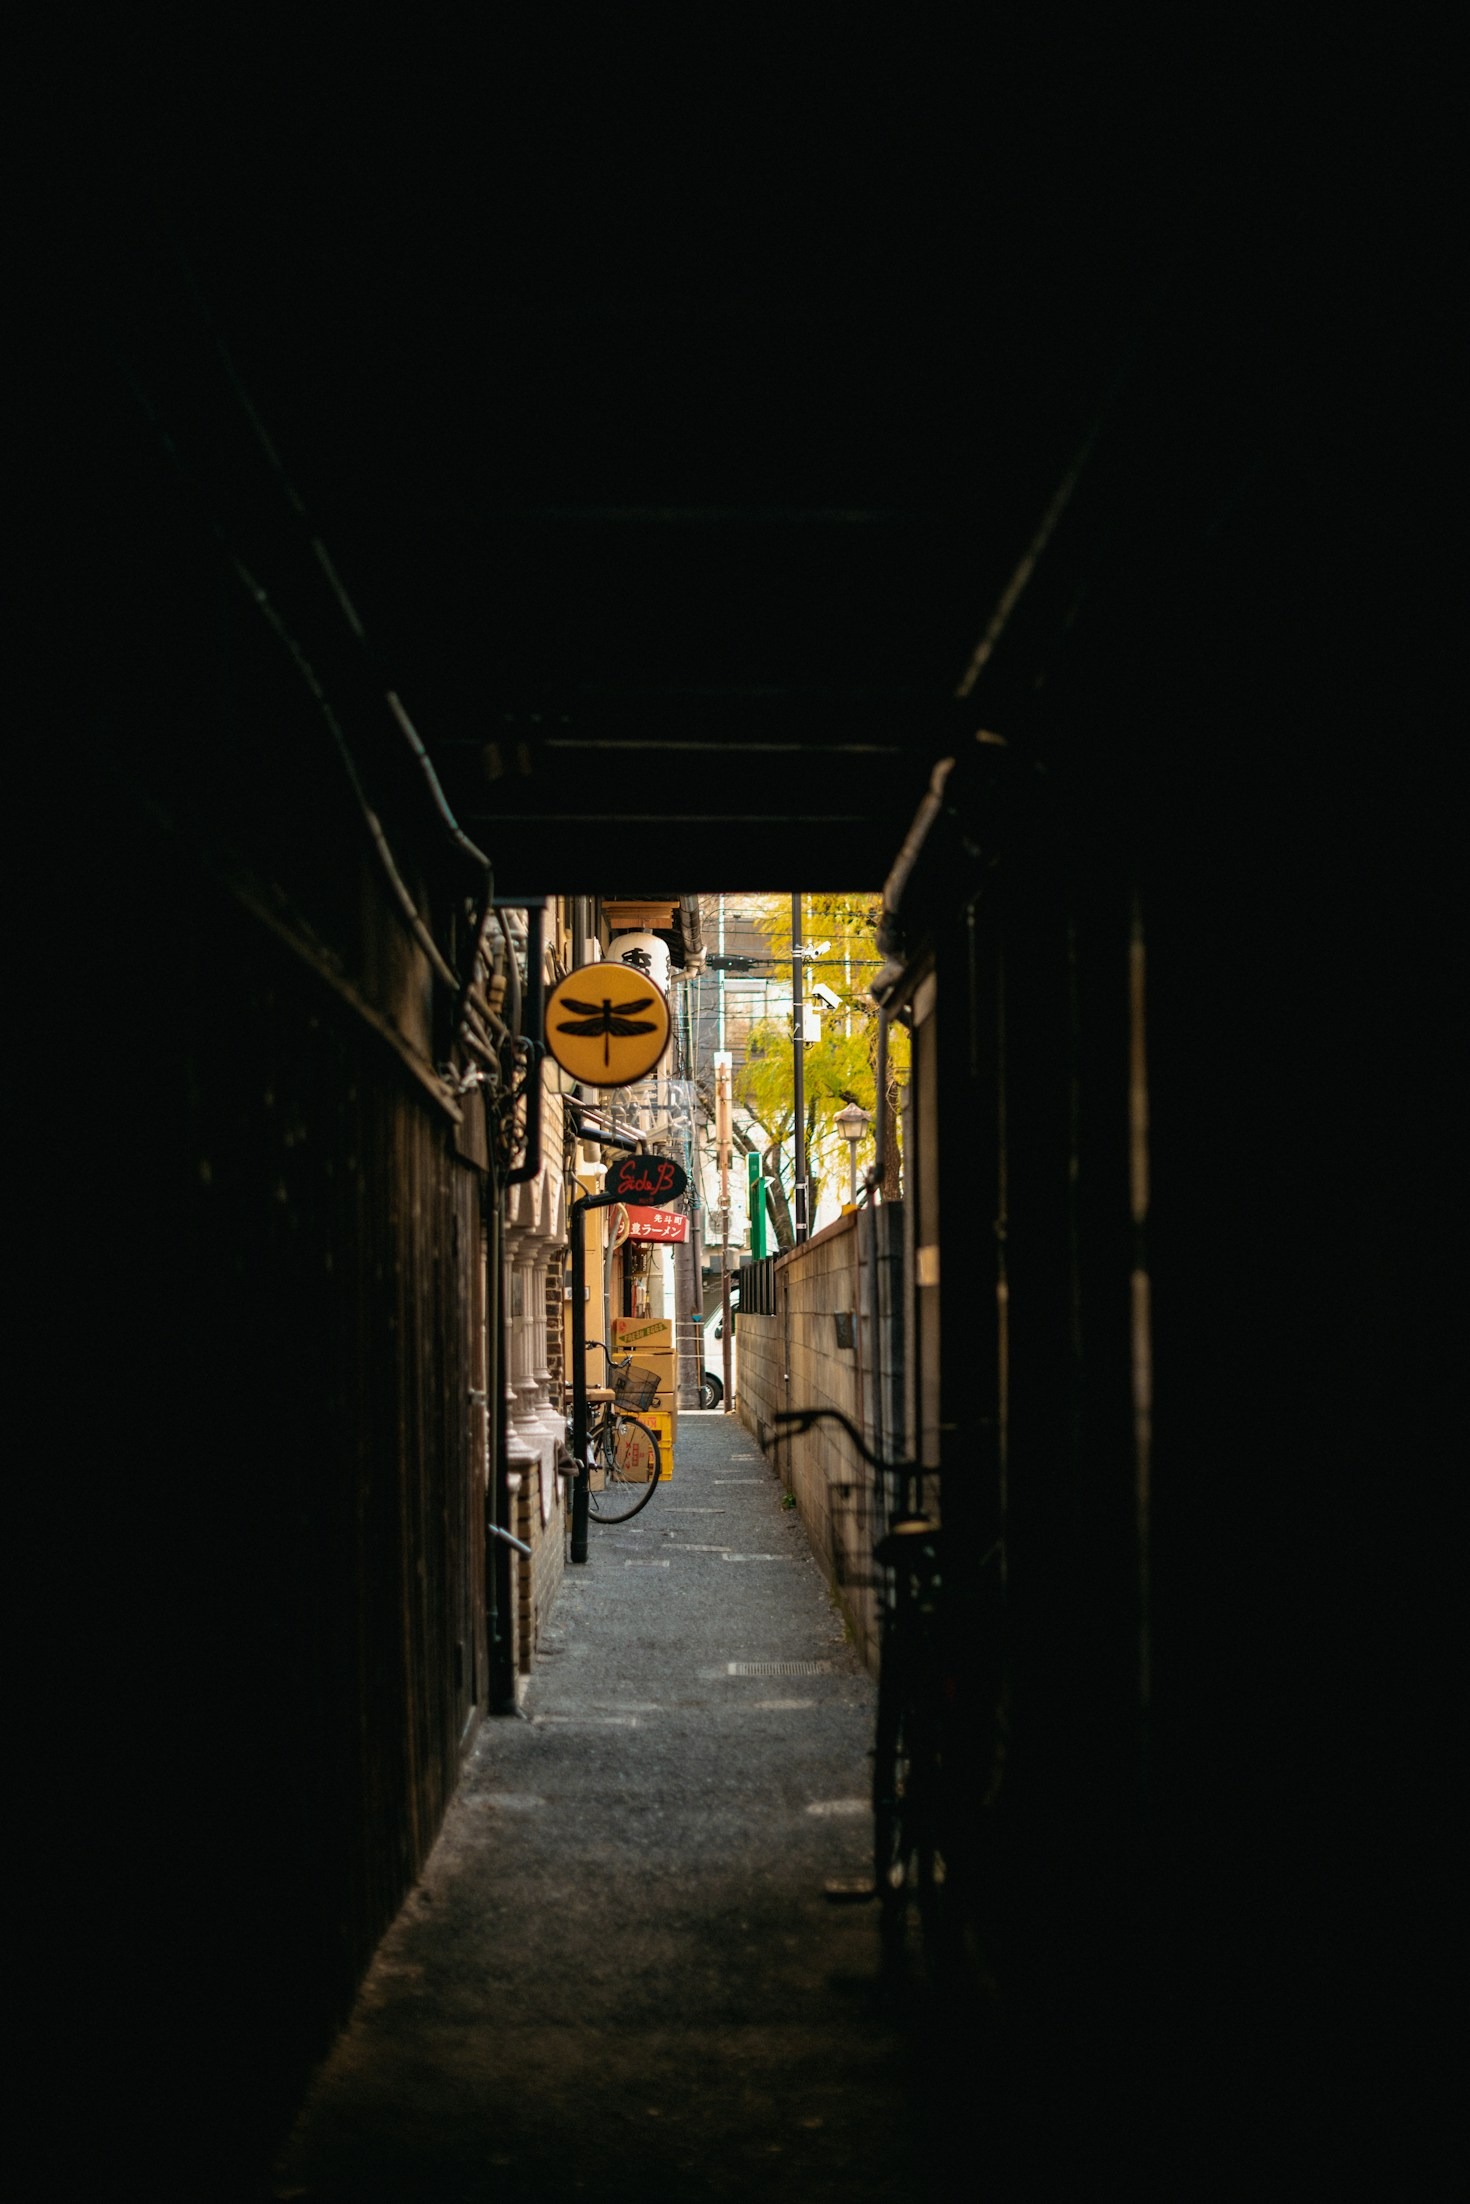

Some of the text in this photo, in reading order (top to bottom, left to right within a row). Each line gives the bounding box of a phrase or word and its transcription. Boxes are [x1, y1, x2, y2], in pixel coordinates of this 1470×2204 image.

[618, 1160, 675, 1195] Side B
[654, 1214, 683, 1226] 先斗町
[624, 1323, 664, 1342] FRESH EGGS
